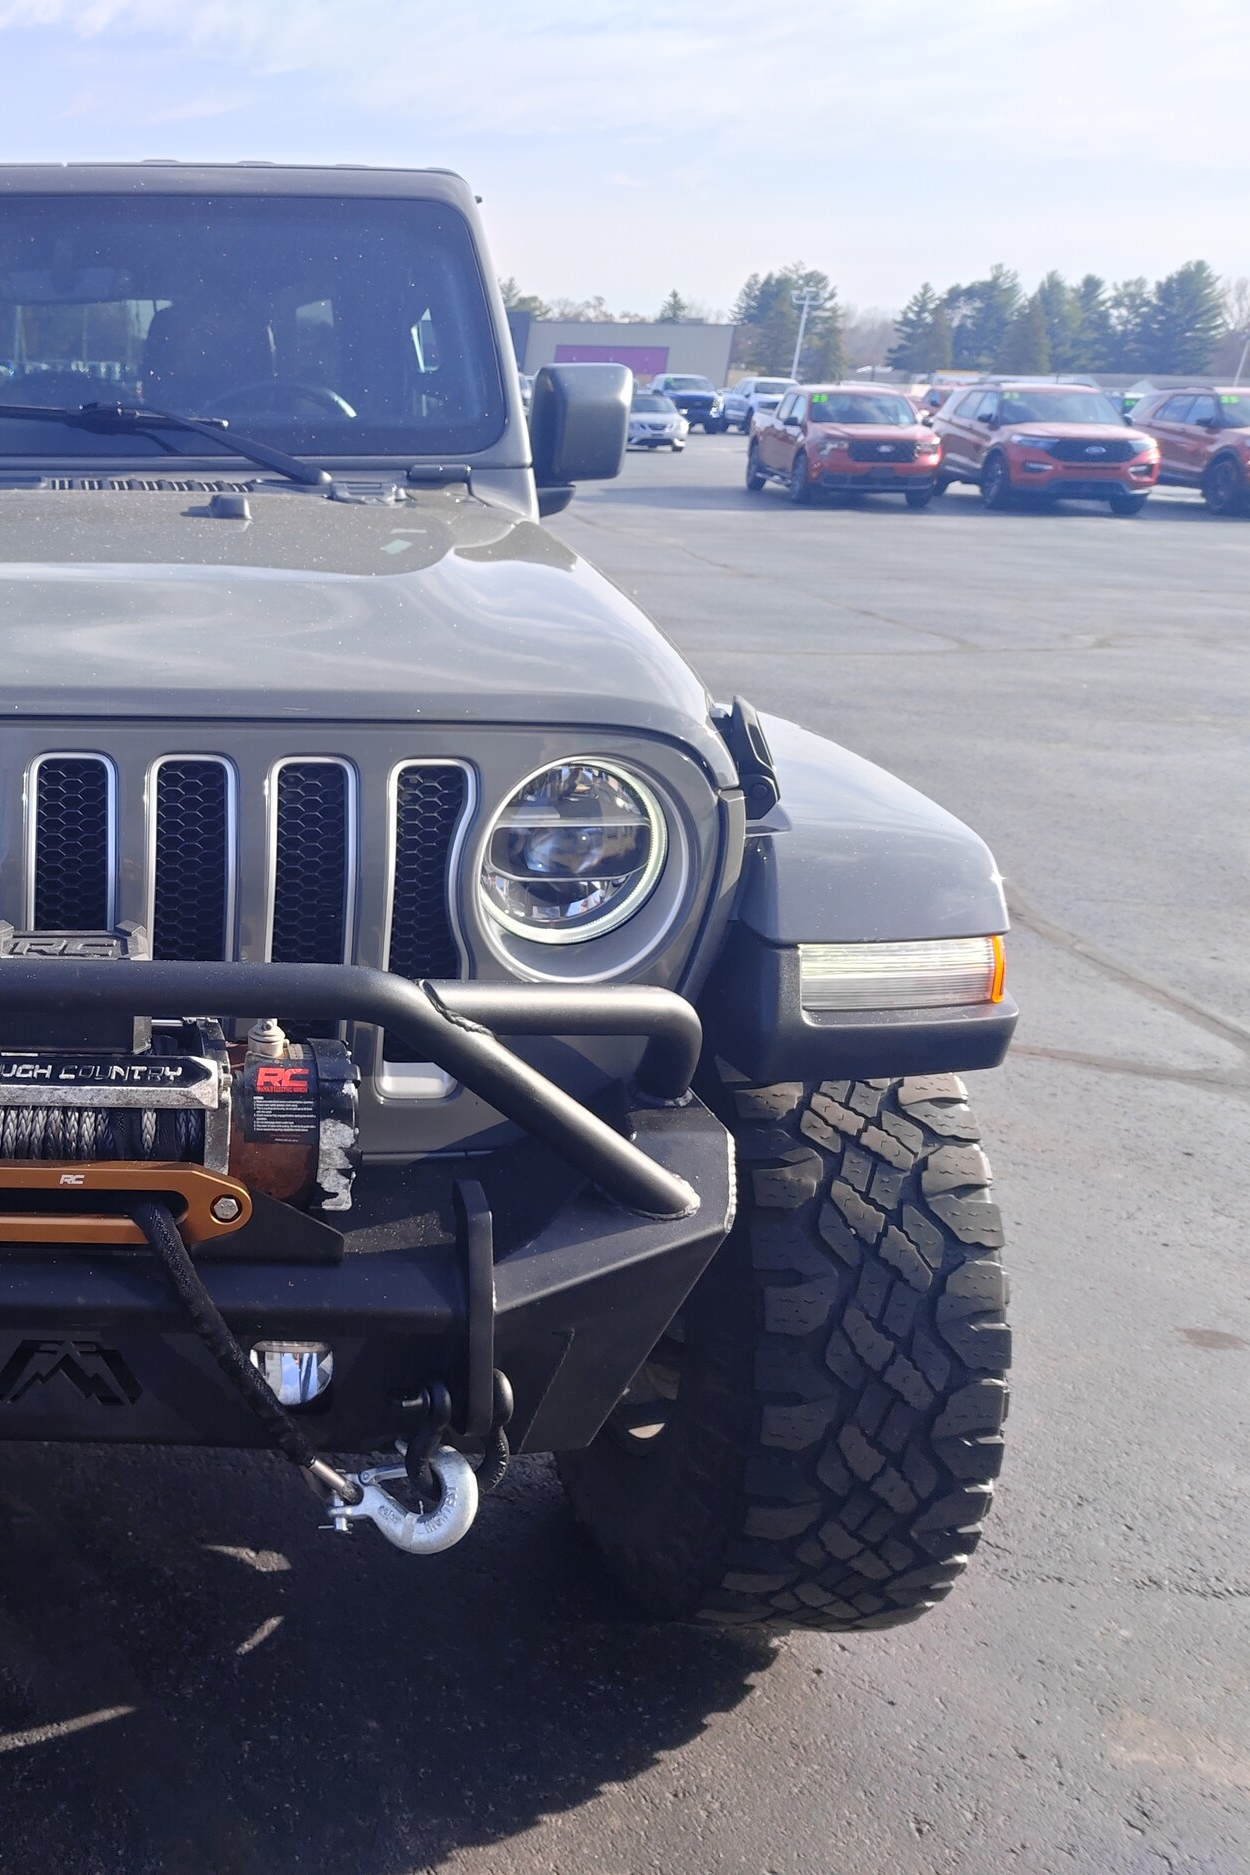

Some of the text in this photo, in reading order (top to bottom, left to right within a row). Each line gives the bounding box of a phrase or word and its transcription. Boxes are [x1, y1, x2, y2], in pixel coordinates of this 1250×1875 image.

[58, 1064, 183, 1082] COUNTRY
[257, 1067, 309, 1086] RC
[59, 1174, 85, 1185] RC
